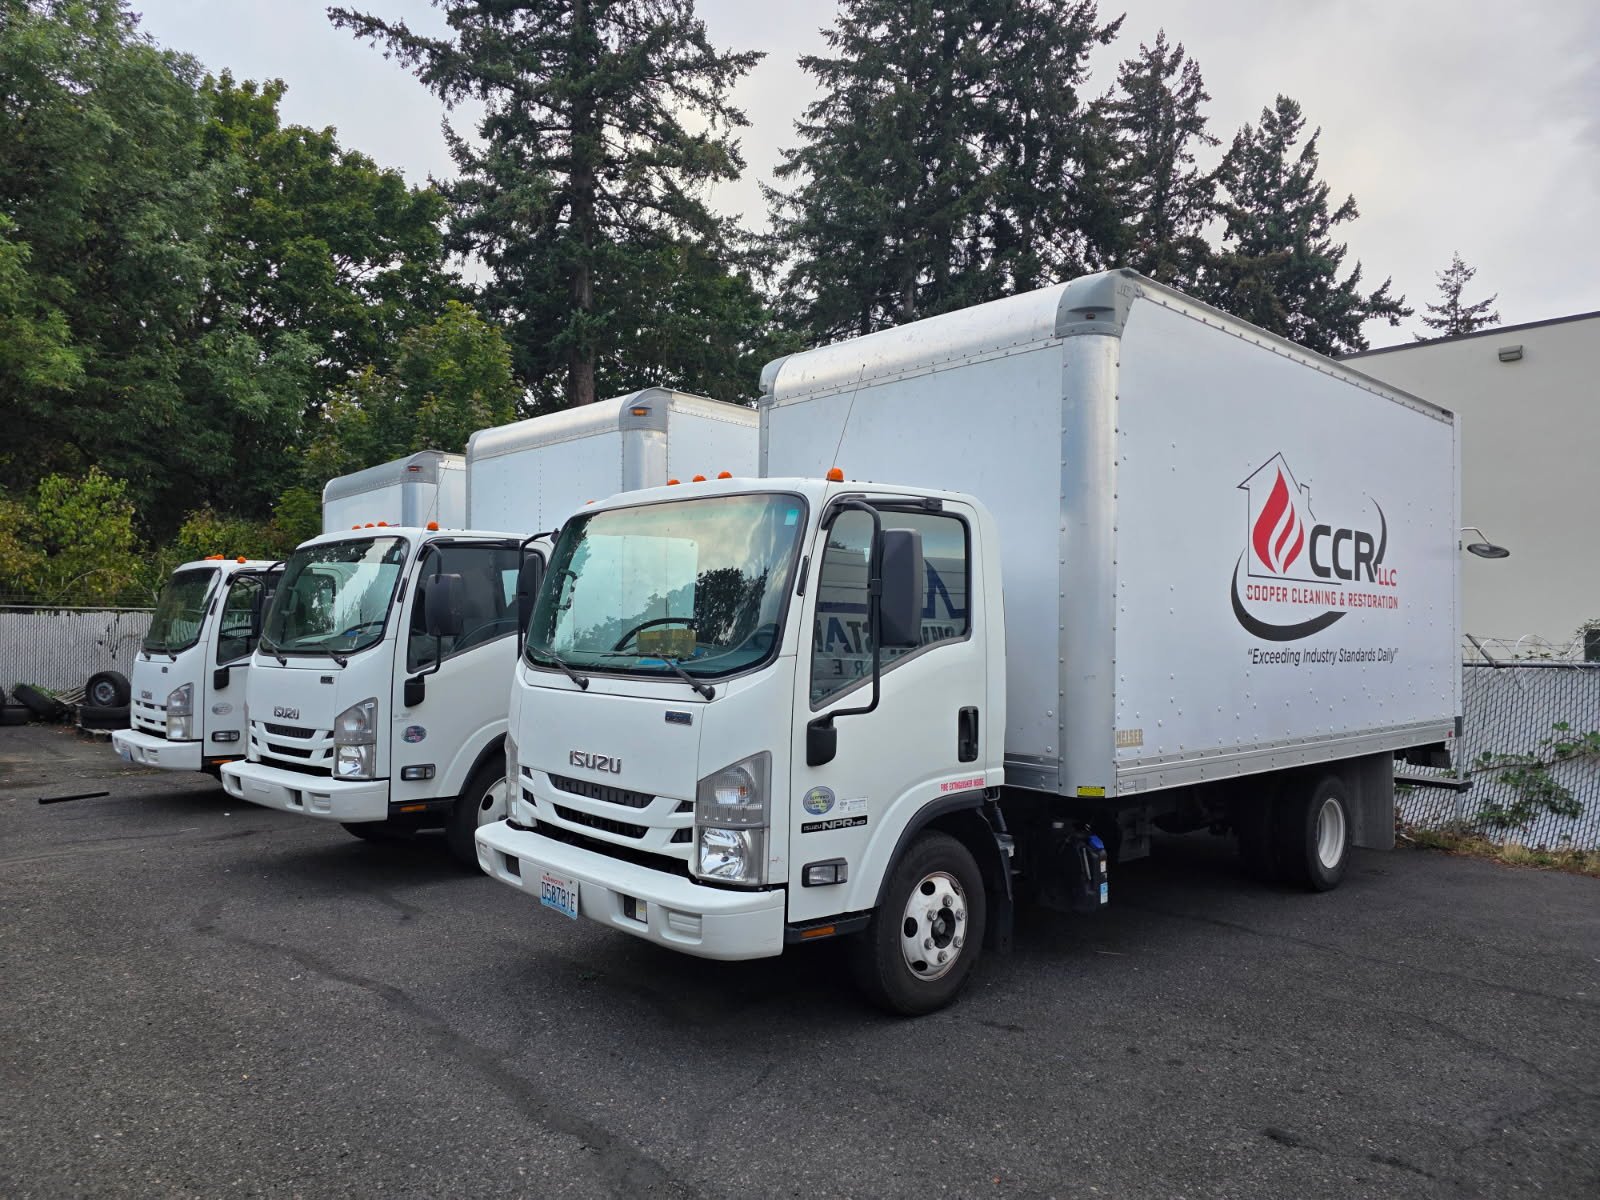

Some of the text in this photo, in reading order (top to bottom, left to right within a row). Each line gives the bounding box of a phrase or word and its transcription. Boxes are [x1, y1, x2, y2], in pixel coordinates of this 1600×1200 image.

[1309, 524, 1376, 583] CCR
[1378, 567, 1397, 587] LLC
[1247, 585, 1398, 609] COOPER CLEANING & RESTORATION
[1303, 648, 1337, 666] Industry
[1339, 648, 1376, 662] Standards
[274, 706, 299, 719] ISUZU
[569, 750, 622, 774] ISUZU
[822, 818, 853, 830] NPR
